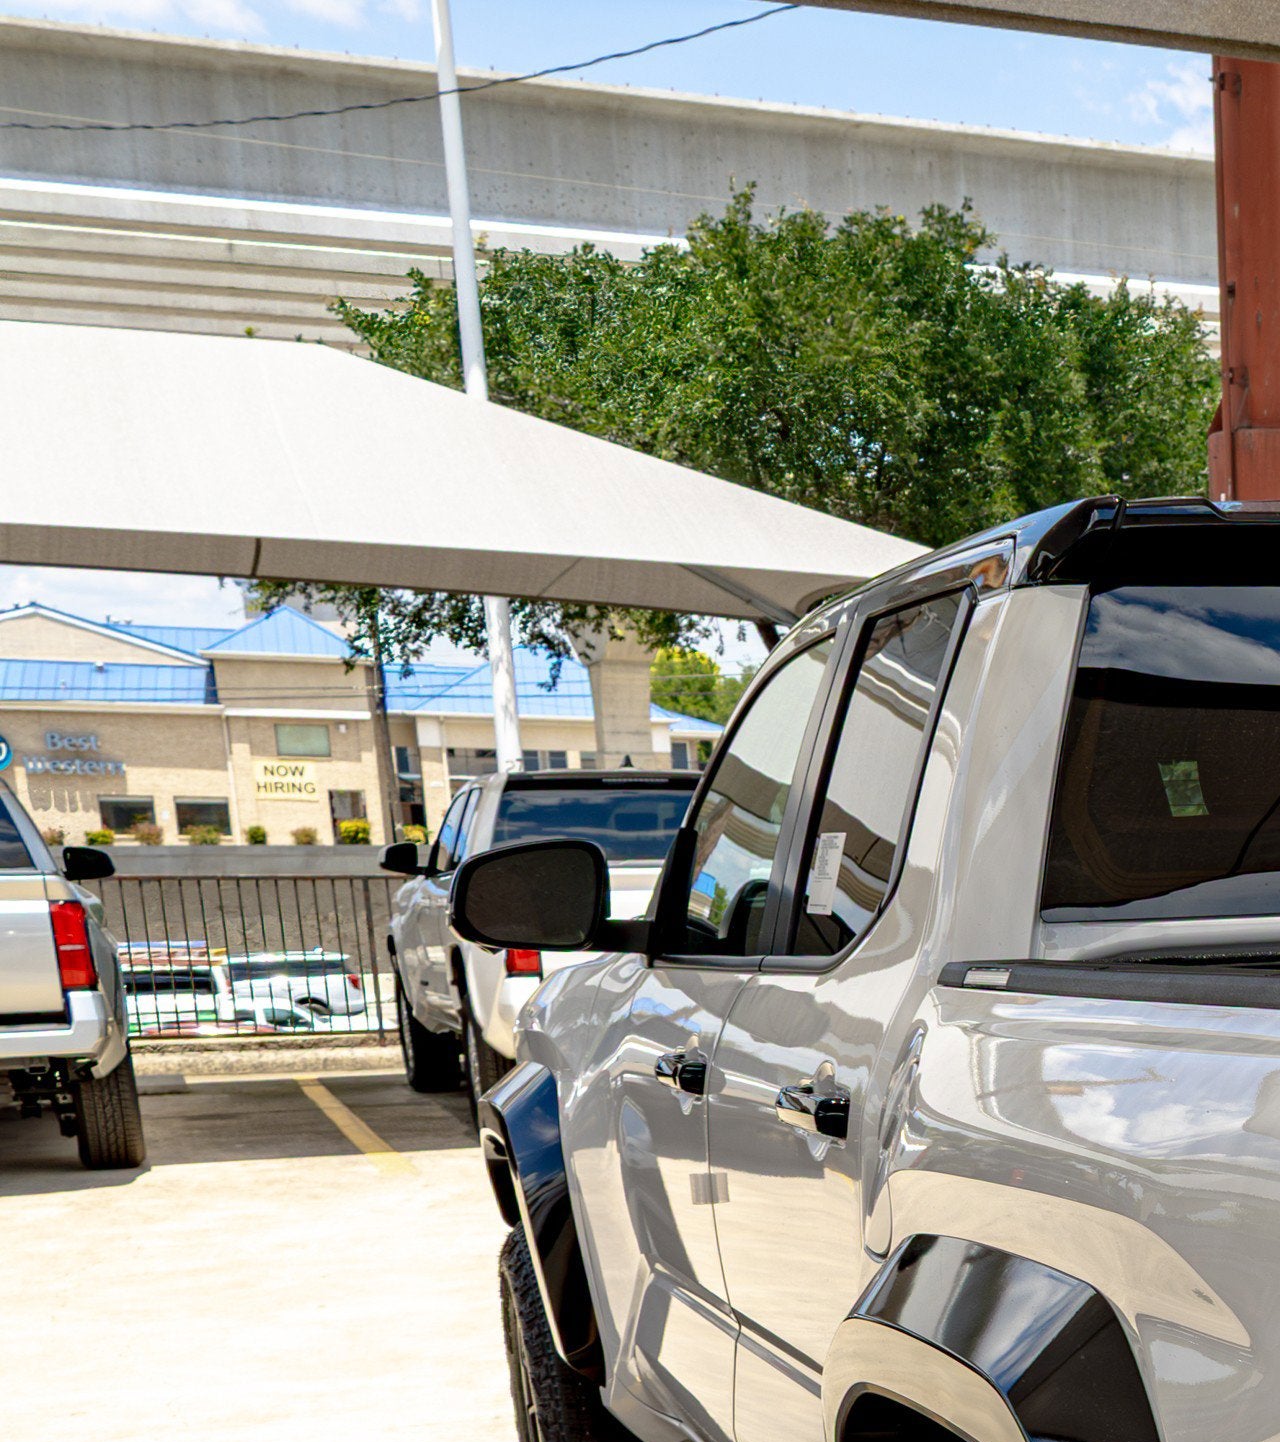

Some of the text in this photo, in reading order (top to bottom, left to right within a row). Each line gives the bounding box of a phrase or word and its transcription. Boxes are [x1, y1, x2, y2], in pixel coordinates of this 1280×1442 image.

[45, 731, 100, 750] Best
[22, 756, 126, 775] Western
[263, 764, 305, 777] NOW
[257, 781, 316, 794] HIRING
